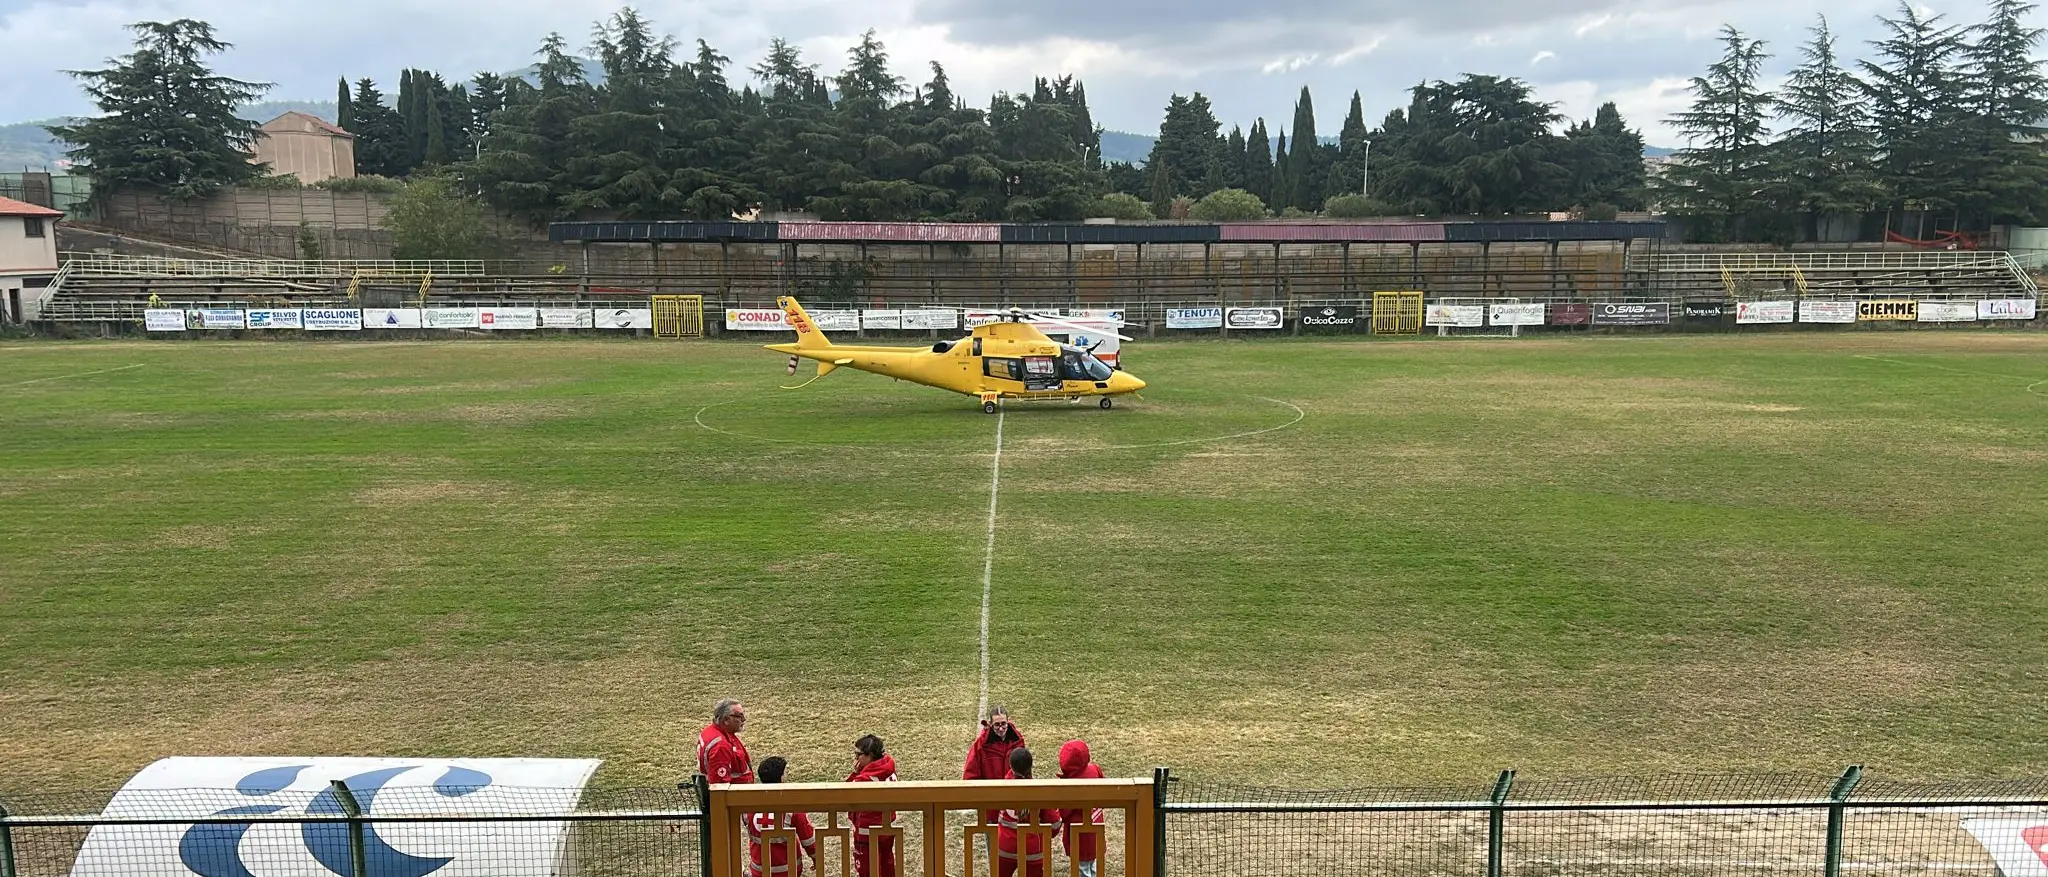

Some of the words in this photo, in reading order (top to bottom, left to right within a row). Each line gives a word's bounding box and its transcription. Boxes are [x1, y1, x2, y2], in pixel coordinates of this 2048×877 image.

[1177, 308, 1221, 318] TENUTA
[1860, 303, 1915, 315] GIEMME
[305, 310, 360, 319] SCAGLIONE
[738, 312, 781, 322] CONAD
